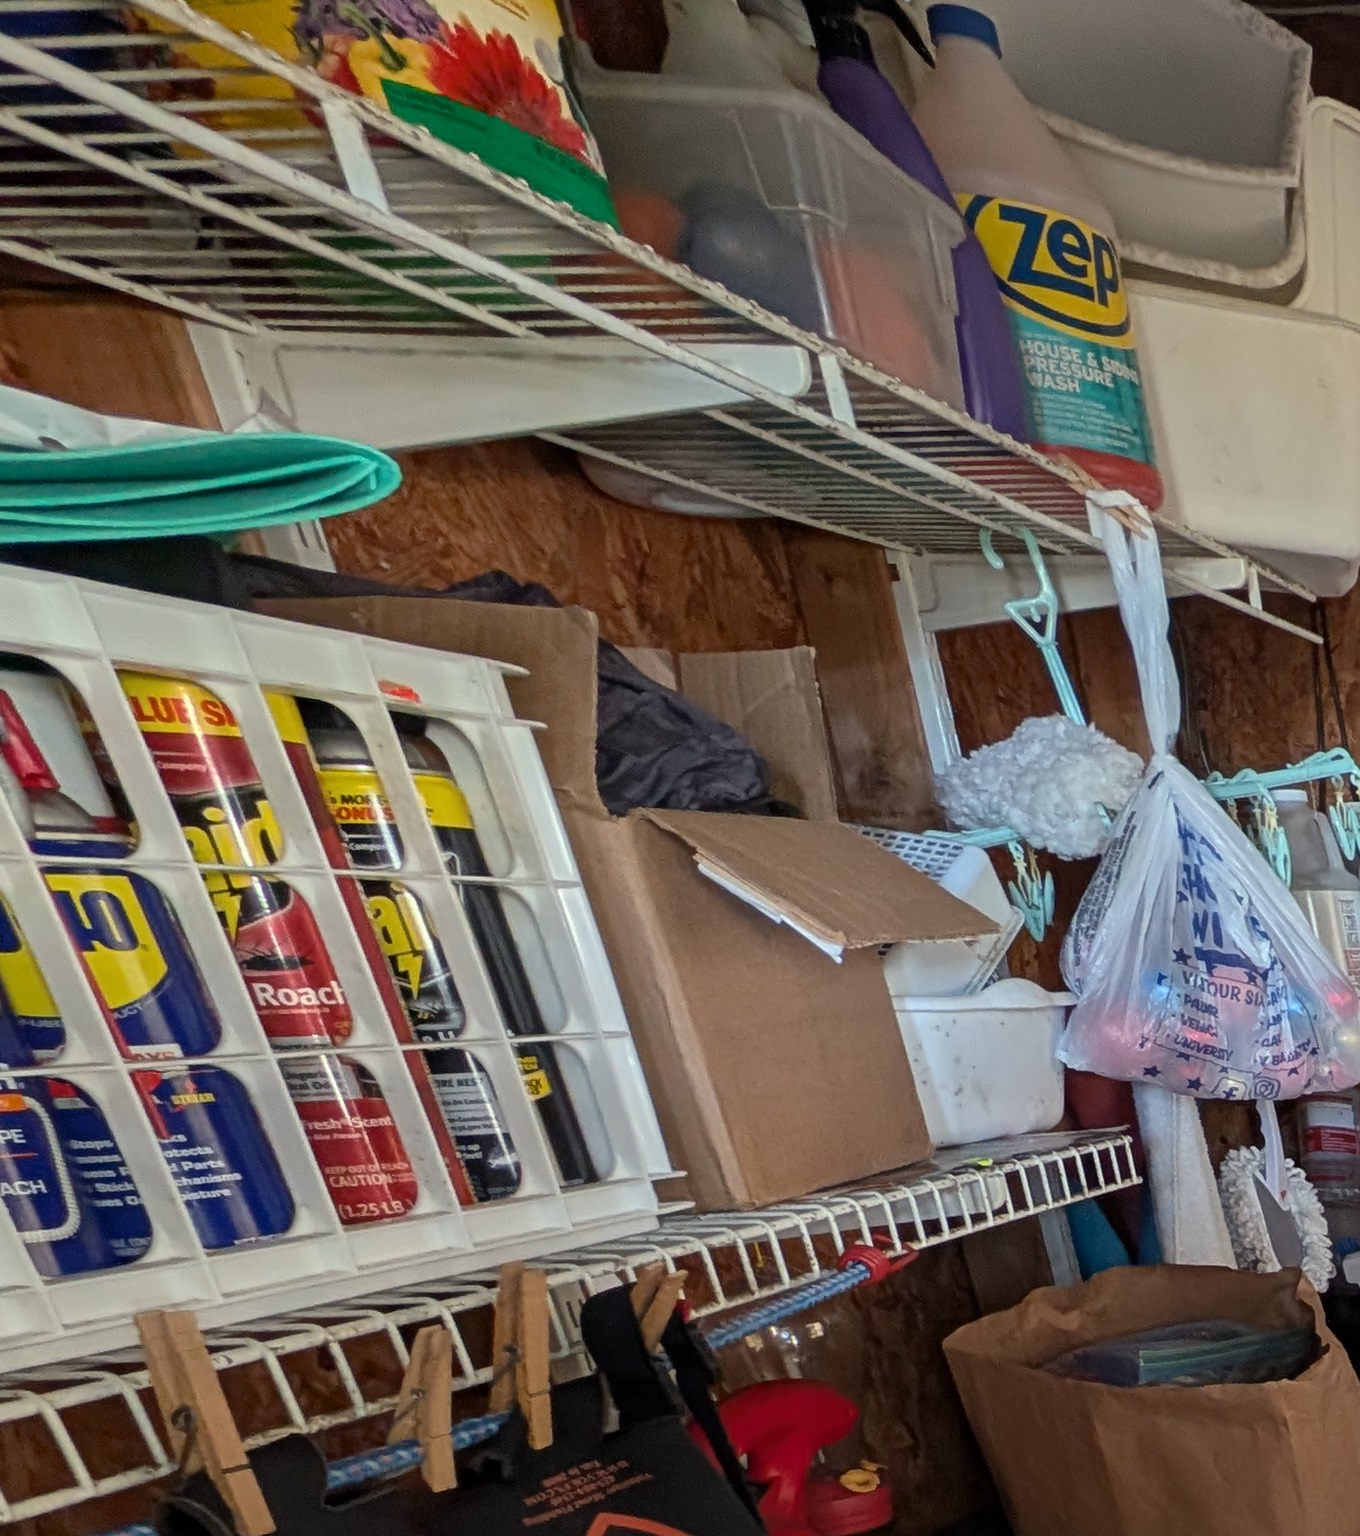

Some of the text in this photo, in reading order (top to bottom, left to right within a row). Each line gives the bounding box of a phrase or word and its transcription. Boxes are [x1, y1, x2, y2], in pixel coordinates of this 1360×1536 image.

[998, 203, 1119, 308] Zep
[1020, 338, 1083, 364] HOUSE
[1086, 352, 1098, 368] &
[1023, 356, 1115, 388] PRESSURE
[1027, 373, 1081, 393] WASH
[333, 806, 396, 821] ONUS
[183, 800, 286, 894] aid
[176, 1172, 243, 1187] chanisms
